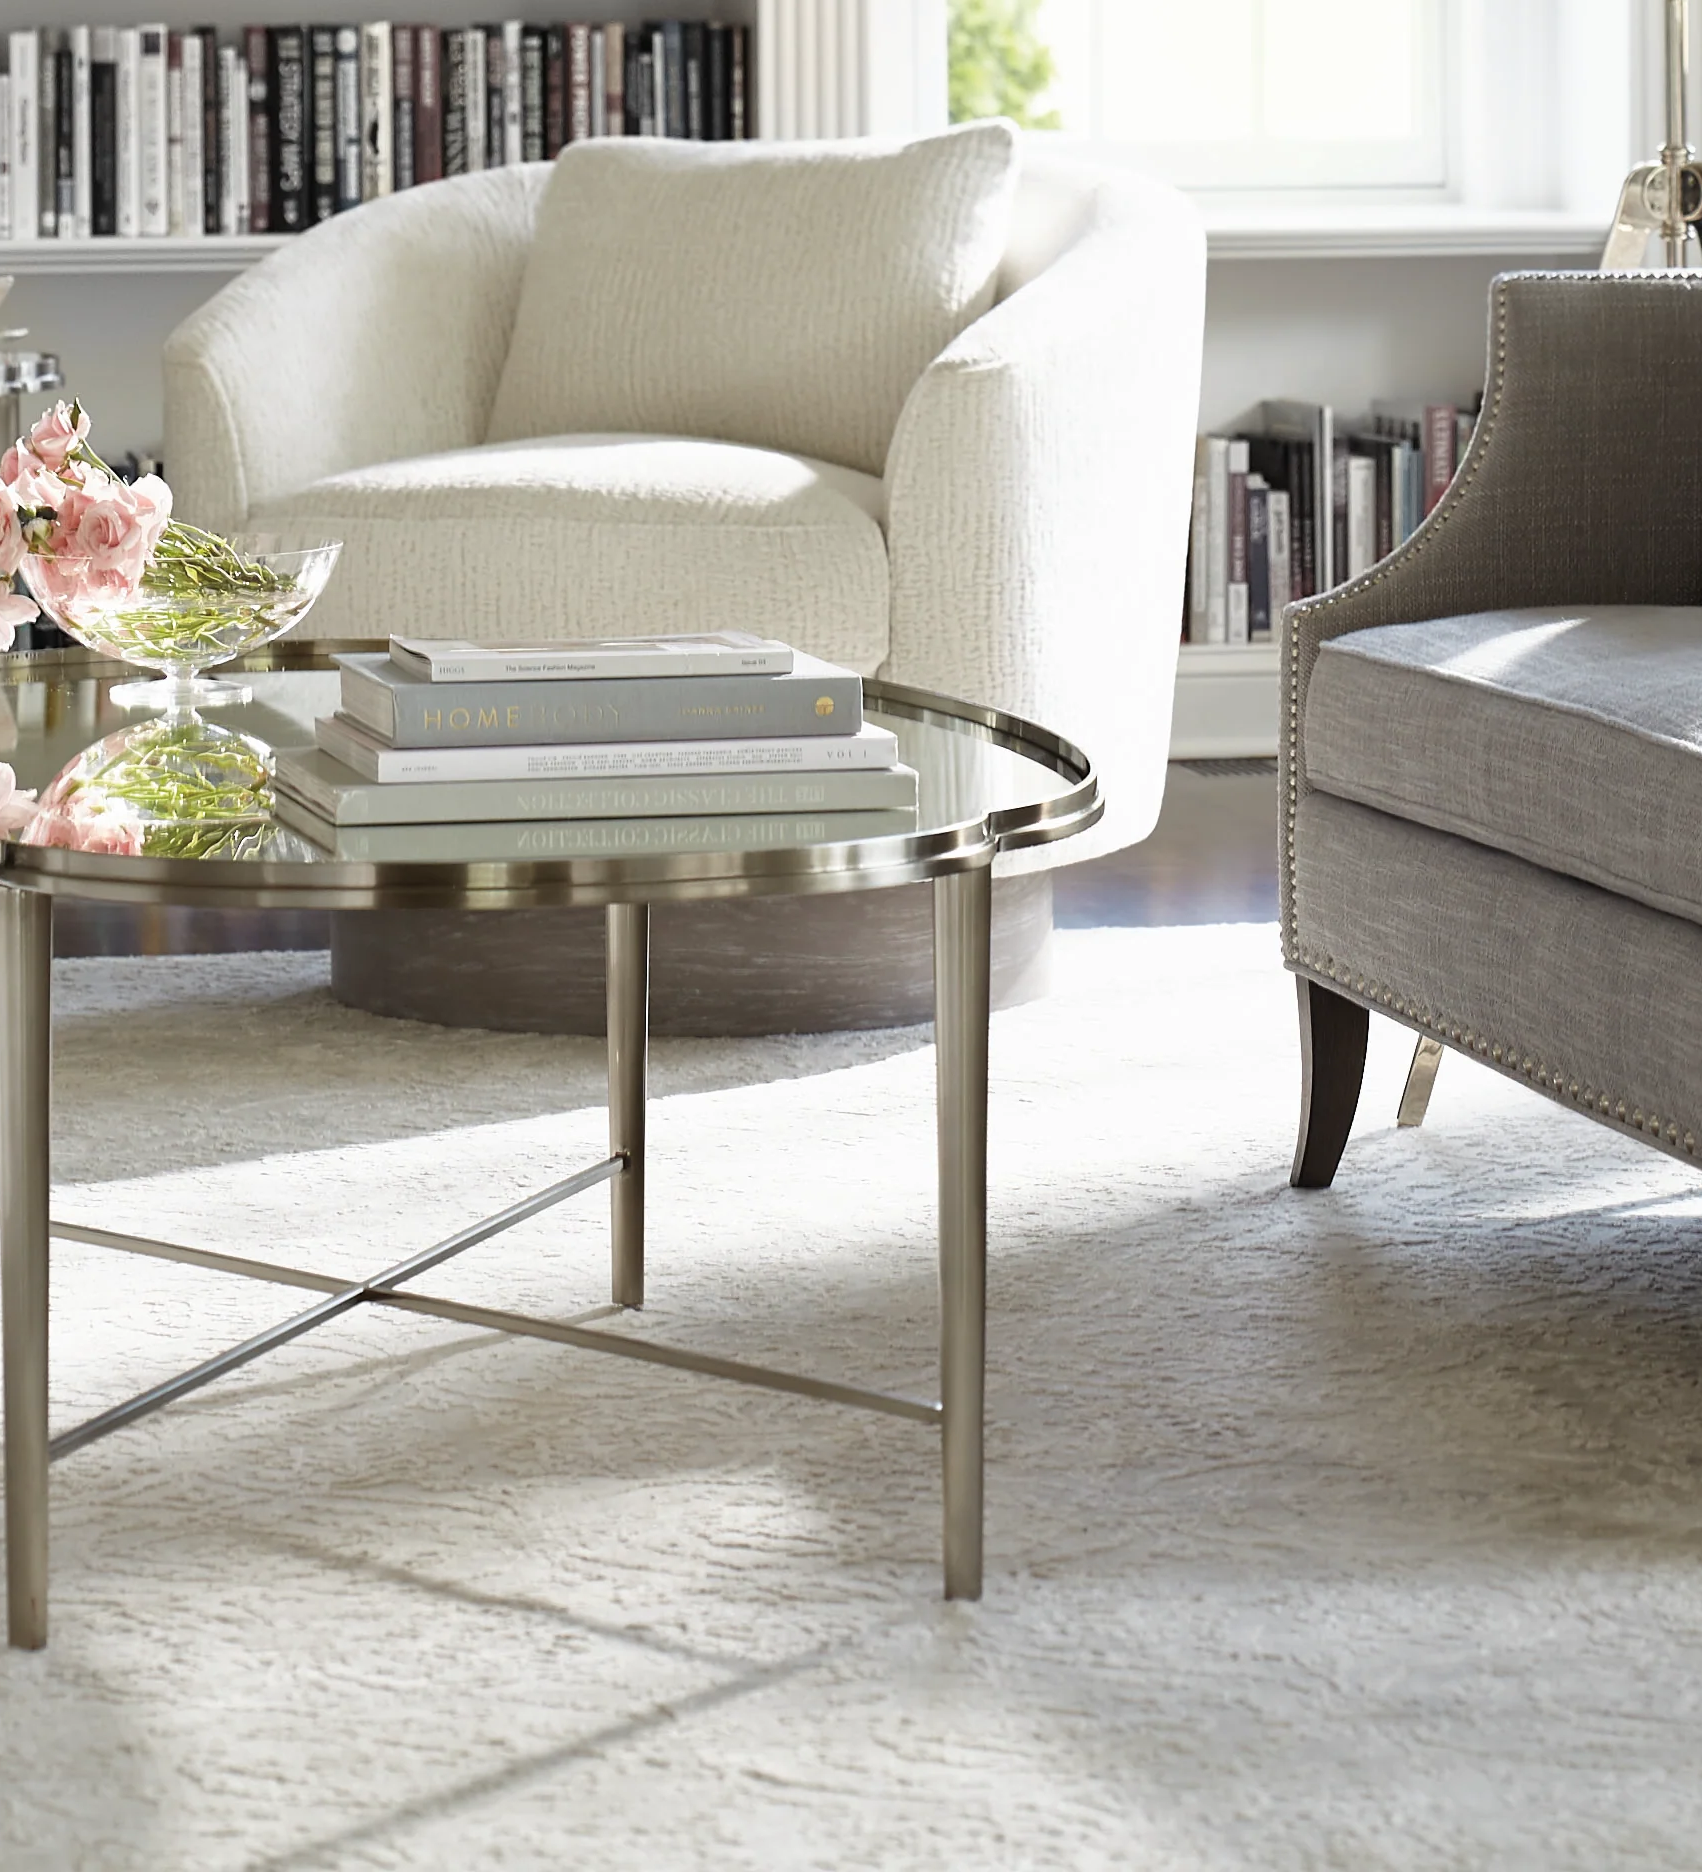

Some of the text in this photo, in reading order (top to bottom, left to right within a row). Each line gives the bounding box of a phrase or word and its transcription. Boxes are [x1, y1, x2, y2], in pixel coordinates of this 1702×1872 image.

[505, 664, 517, 673] The
[542, 663, 566, 672] Fashion
[567, 663, 596, 672] Magazine
[826, 749, 852, 759] VOL
[517, 789, 649, 812] COLLECTION
[654, 787, 741, 808] CLASSIC
[746, 786, 788, 805] THE
